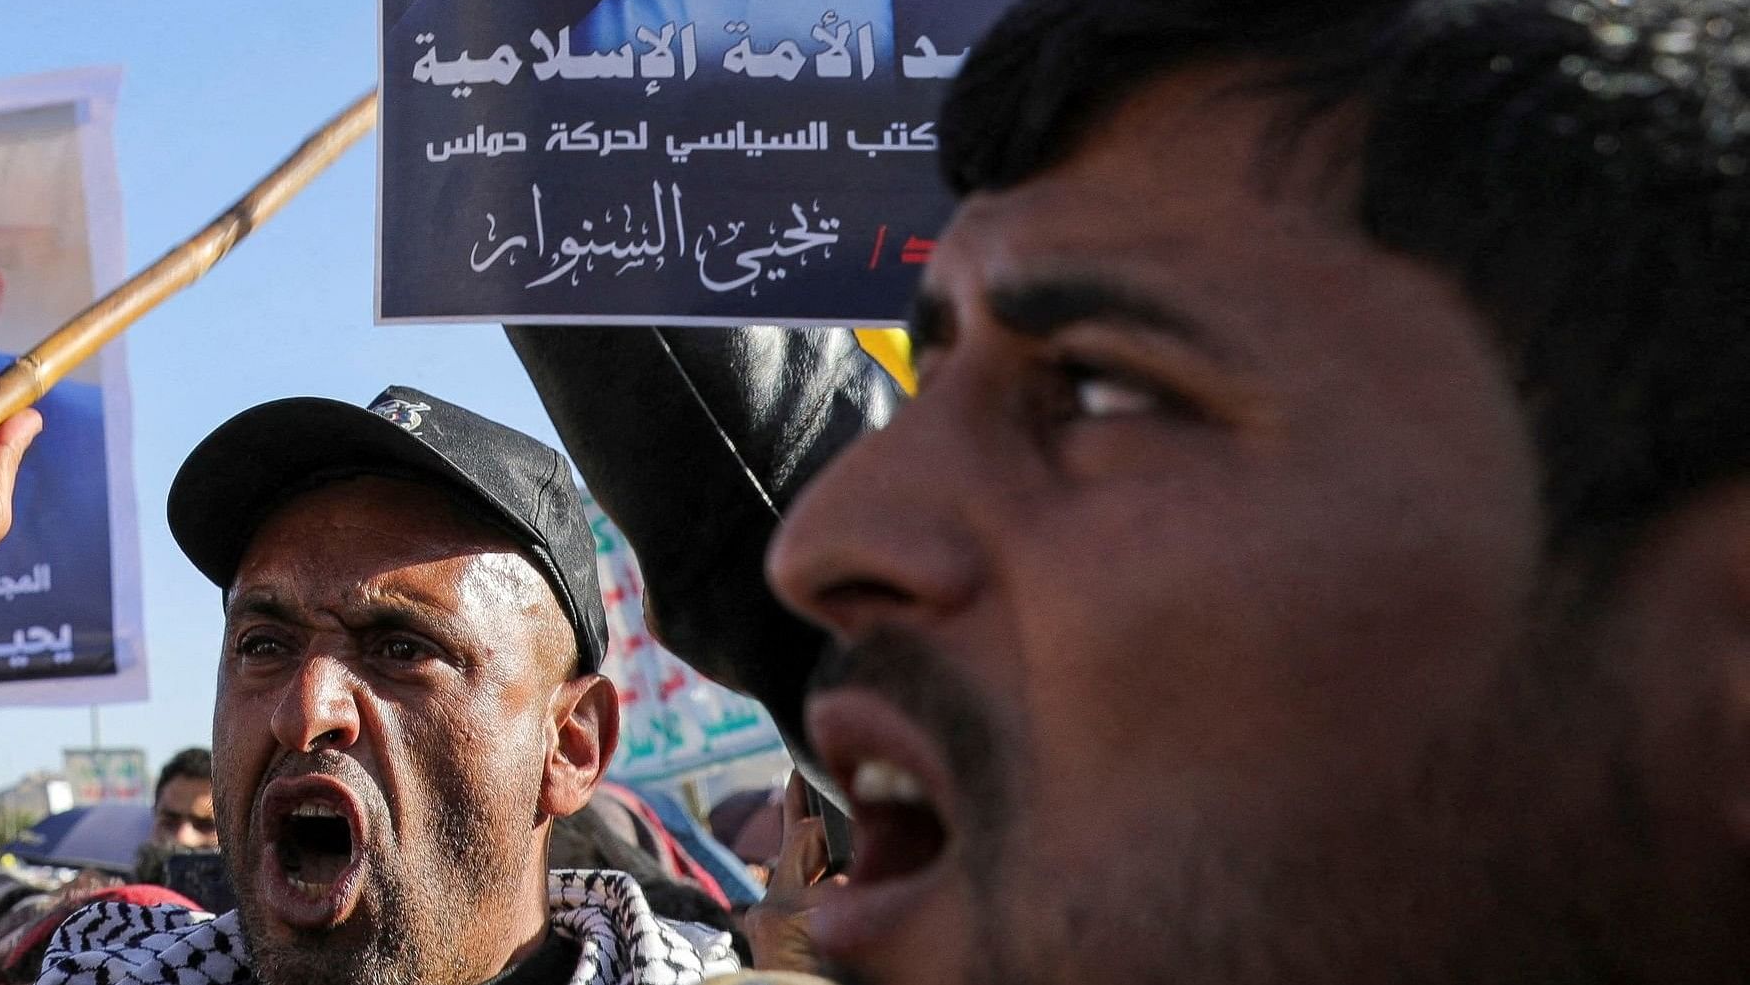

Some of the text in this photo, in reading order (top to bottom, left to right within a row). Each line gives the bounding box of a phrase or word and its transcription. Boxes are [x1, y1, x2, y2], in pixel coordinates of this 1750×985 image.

[411, 20, 698, 98] الإسلامية
[722, 10, 875, 82] الأمة
[426, 124, 527, 163] حماس
[545, 120, 649, 158] لحركة
[666, 121, 828, 163] السياسي
[470, 180, 686, 290] السنوار
